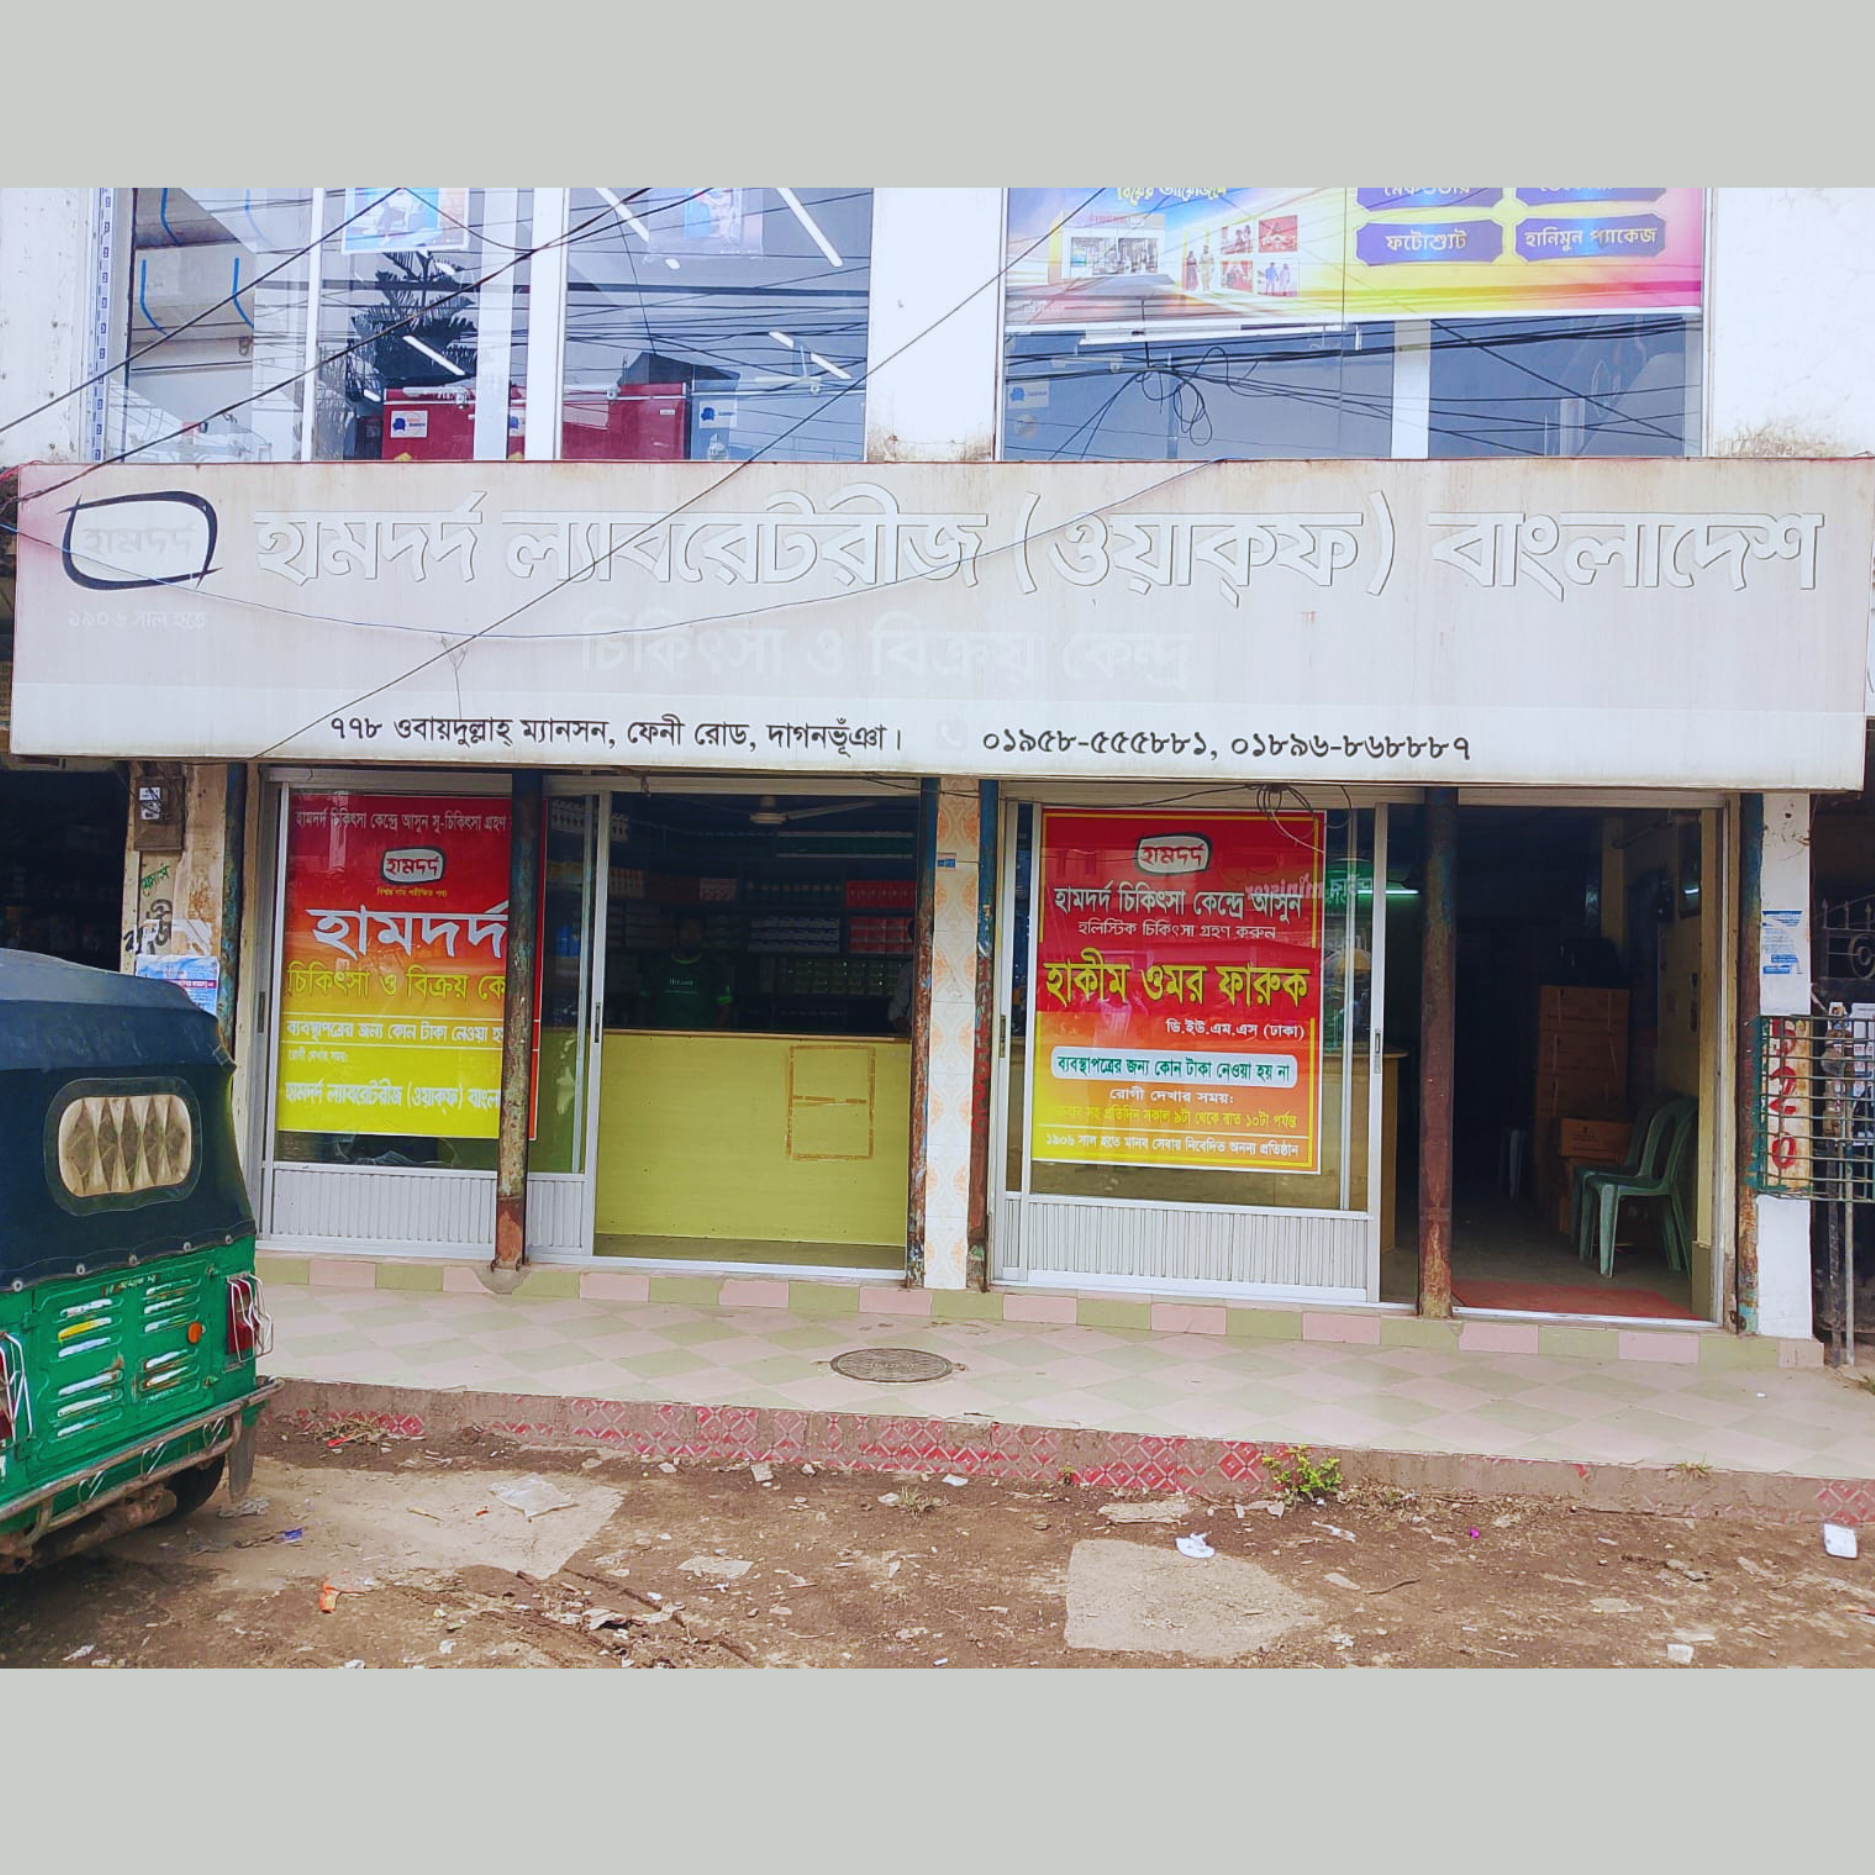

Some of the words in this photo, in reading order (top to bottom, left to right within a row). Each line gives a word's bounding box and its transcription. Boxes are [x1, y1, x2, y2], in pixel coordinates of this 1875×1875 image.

[1524, 226, 1583, 252] হানিমুন
[1589, 227, 1658, 247] প্যাকেজ
[78, 523, 196, 557] হামদর্দ
[254, 490, 488, 587] হামদর্দ
[502, 483, 989, 588] ল্যাবরেটরীজ
[1428, 512, 1825, 603] বাংলাদেশ
[132, 611, 168, 630] সাল
[173, 611, 207, 630] হতে
[580, 605, 785, 678] চিকিৎসা
[806, 628, 844, 672] ও
[870, 609, 1036, 679] বিক্রয়
[1062, 630, 1194, 690] কেন্দ্র
[331, 717, 383, 739] ৭৭৮
[394, 716, 513, 748] ওবায়দুল্লাহ্
[519, 717, 616, 749] ম্যানসন,
[627, 714, 685, 746] ফেনী
[694, 721, 757, 752] রোড,
[983, 728, 1219, 761] ০১৯৫৮-৫৫৫৮৮১,
[1231, 732, 1472, 762] ০১৮৯৬-৮৬৮৮৮৭
[295, 808, 327, 829] হামদর্দ
[331, 807, 367, 829] চিকিৎসা
[370, 812, 399, 831] কেন্দ্রে
[386, 855, 440, 877] হামদর্দ
[1141, 843, 1205, 866] হামদর্দ
[1054, 880, 1114, 916] হামদর্দ
[1118, 881, 1186, 917] চিকিৎসা
[1193, 891, 1245, 920] কেন্দ্রে
[1248, 890, 1304, 924] আসুন
[305, 900, 510, 962] হামদর্দ
[1078, 918, 1136, 935] হলিস্টিক
[1143, 920, 1195, 938] চিকিৎসা
[1200, 924, 1231, 940] গ্রহণ
[1236, 925, 1277, 940] করুন
[287, 961, 370, 1001] চিকিৎসা
[380, 973, 398, 997] ও
[406, 963, 468, 1001] বিক্রয়
[477, 975, 506, 1004] কে
[1043, 947, 1131, 1008] হাকীম
[1140, 963, 1208, 1006] ওমর
[1215, 961, 1311, 1008] ফারুক
[286, 1020, 355, 1042] ব্যবস্থাপত্রের
[357, 1021, 384, 1039] জন্য
[387, 1022, 417, 1040] কোন
[420, 1018, 448, 1041] টাকা
[451, 1025, 489, 1043] নেওয়া
[1263, 1024, 1306, 1041] (ঢাকা)
[1057, 1055, 1122, 1077] ব্যবস্থাপত্রের
[1126, 1058, 1150, 1077] জন্য
[1154, 1060, 1182, 1078] কোন
[1186, 1057, 1213, 1079] টাকা
[1216, 1062, 1252, 1082] নেওয়া
[1256, 1063, 1273, 1082] হয়
[1277, 1064, 1291, 1082] না
[1110, 1085, 1145, 1102] রোগী
[1151, 1089, 1192, 1103] দেখার
[1245, 1110, 1270, 1128] ১০টা
[1078, 1134, 1097, 1148] সাল
